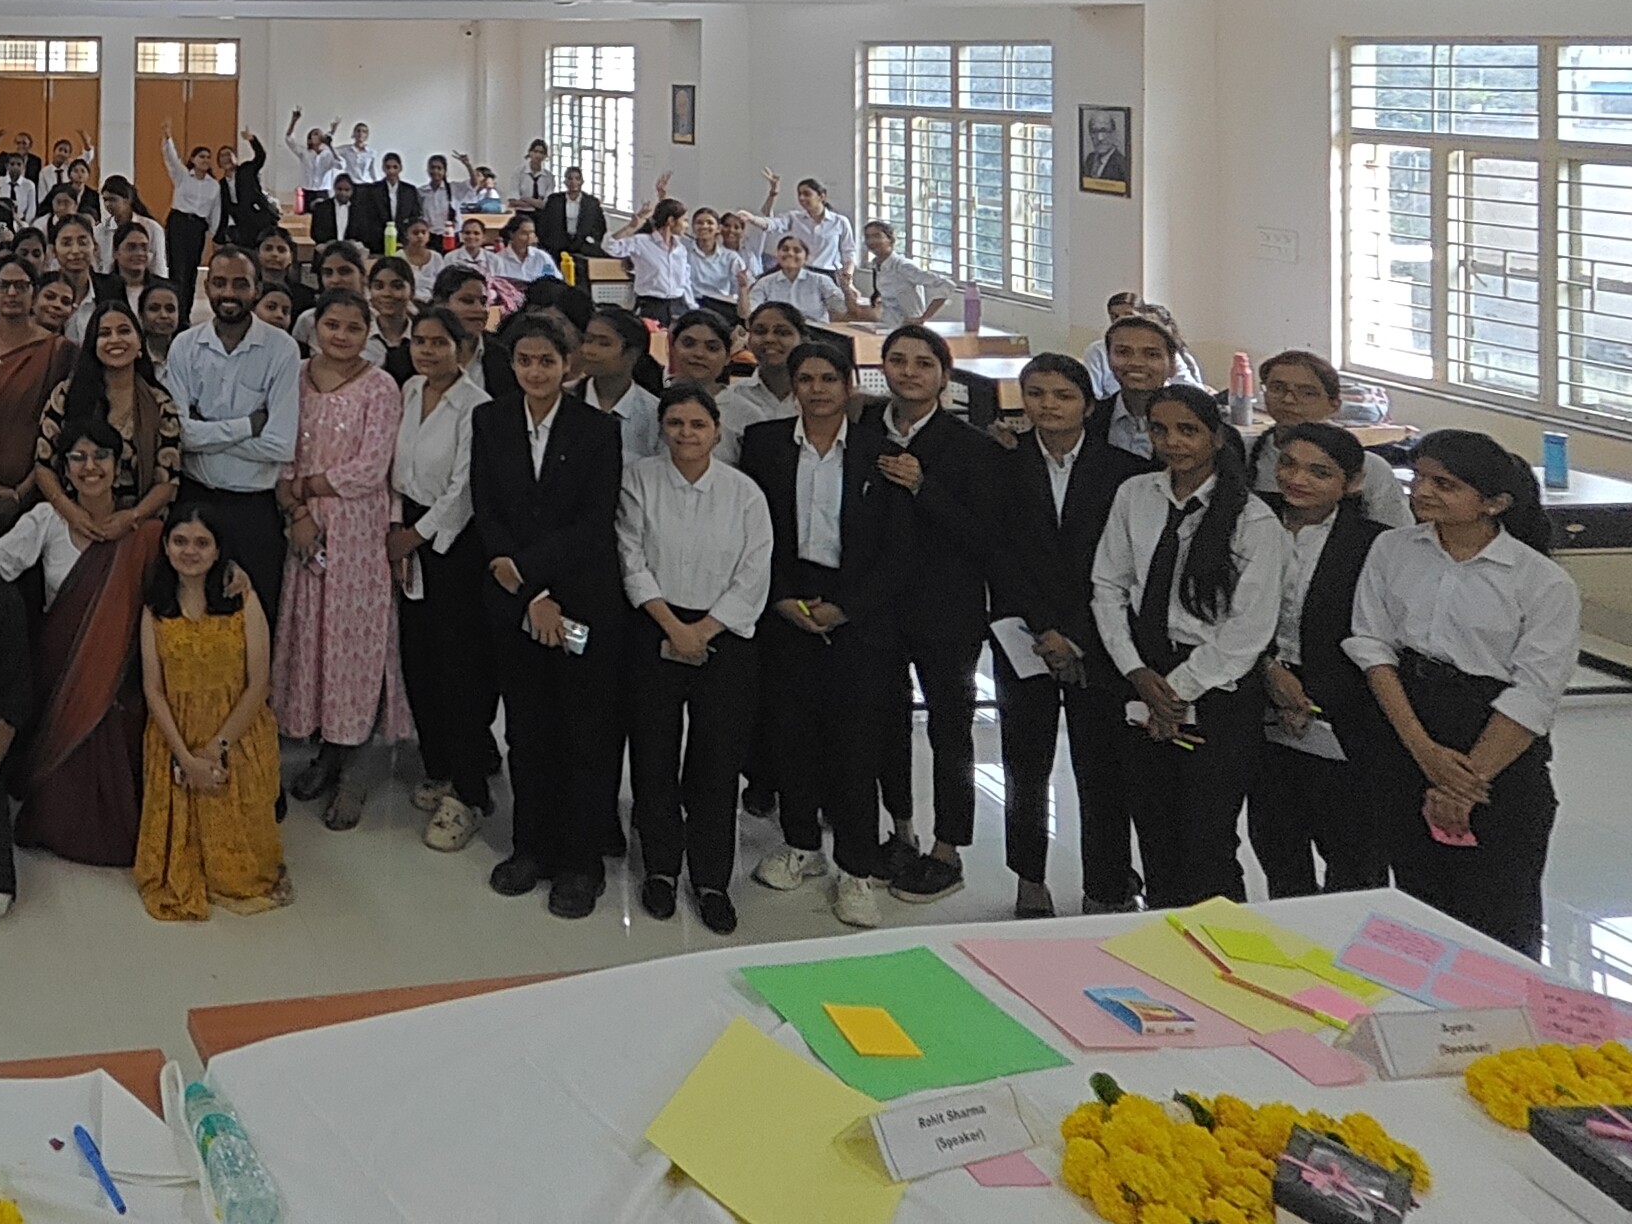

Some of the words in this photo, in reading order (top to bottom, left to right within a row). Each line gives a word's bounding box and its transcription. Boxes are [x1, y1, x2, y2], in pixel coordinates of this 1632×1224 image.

[918, 1113, 945, 1129] Rohit
[946, 1105, 987, 1122] Sharma
[935, 1128, 987, 1153] (Speaker)
